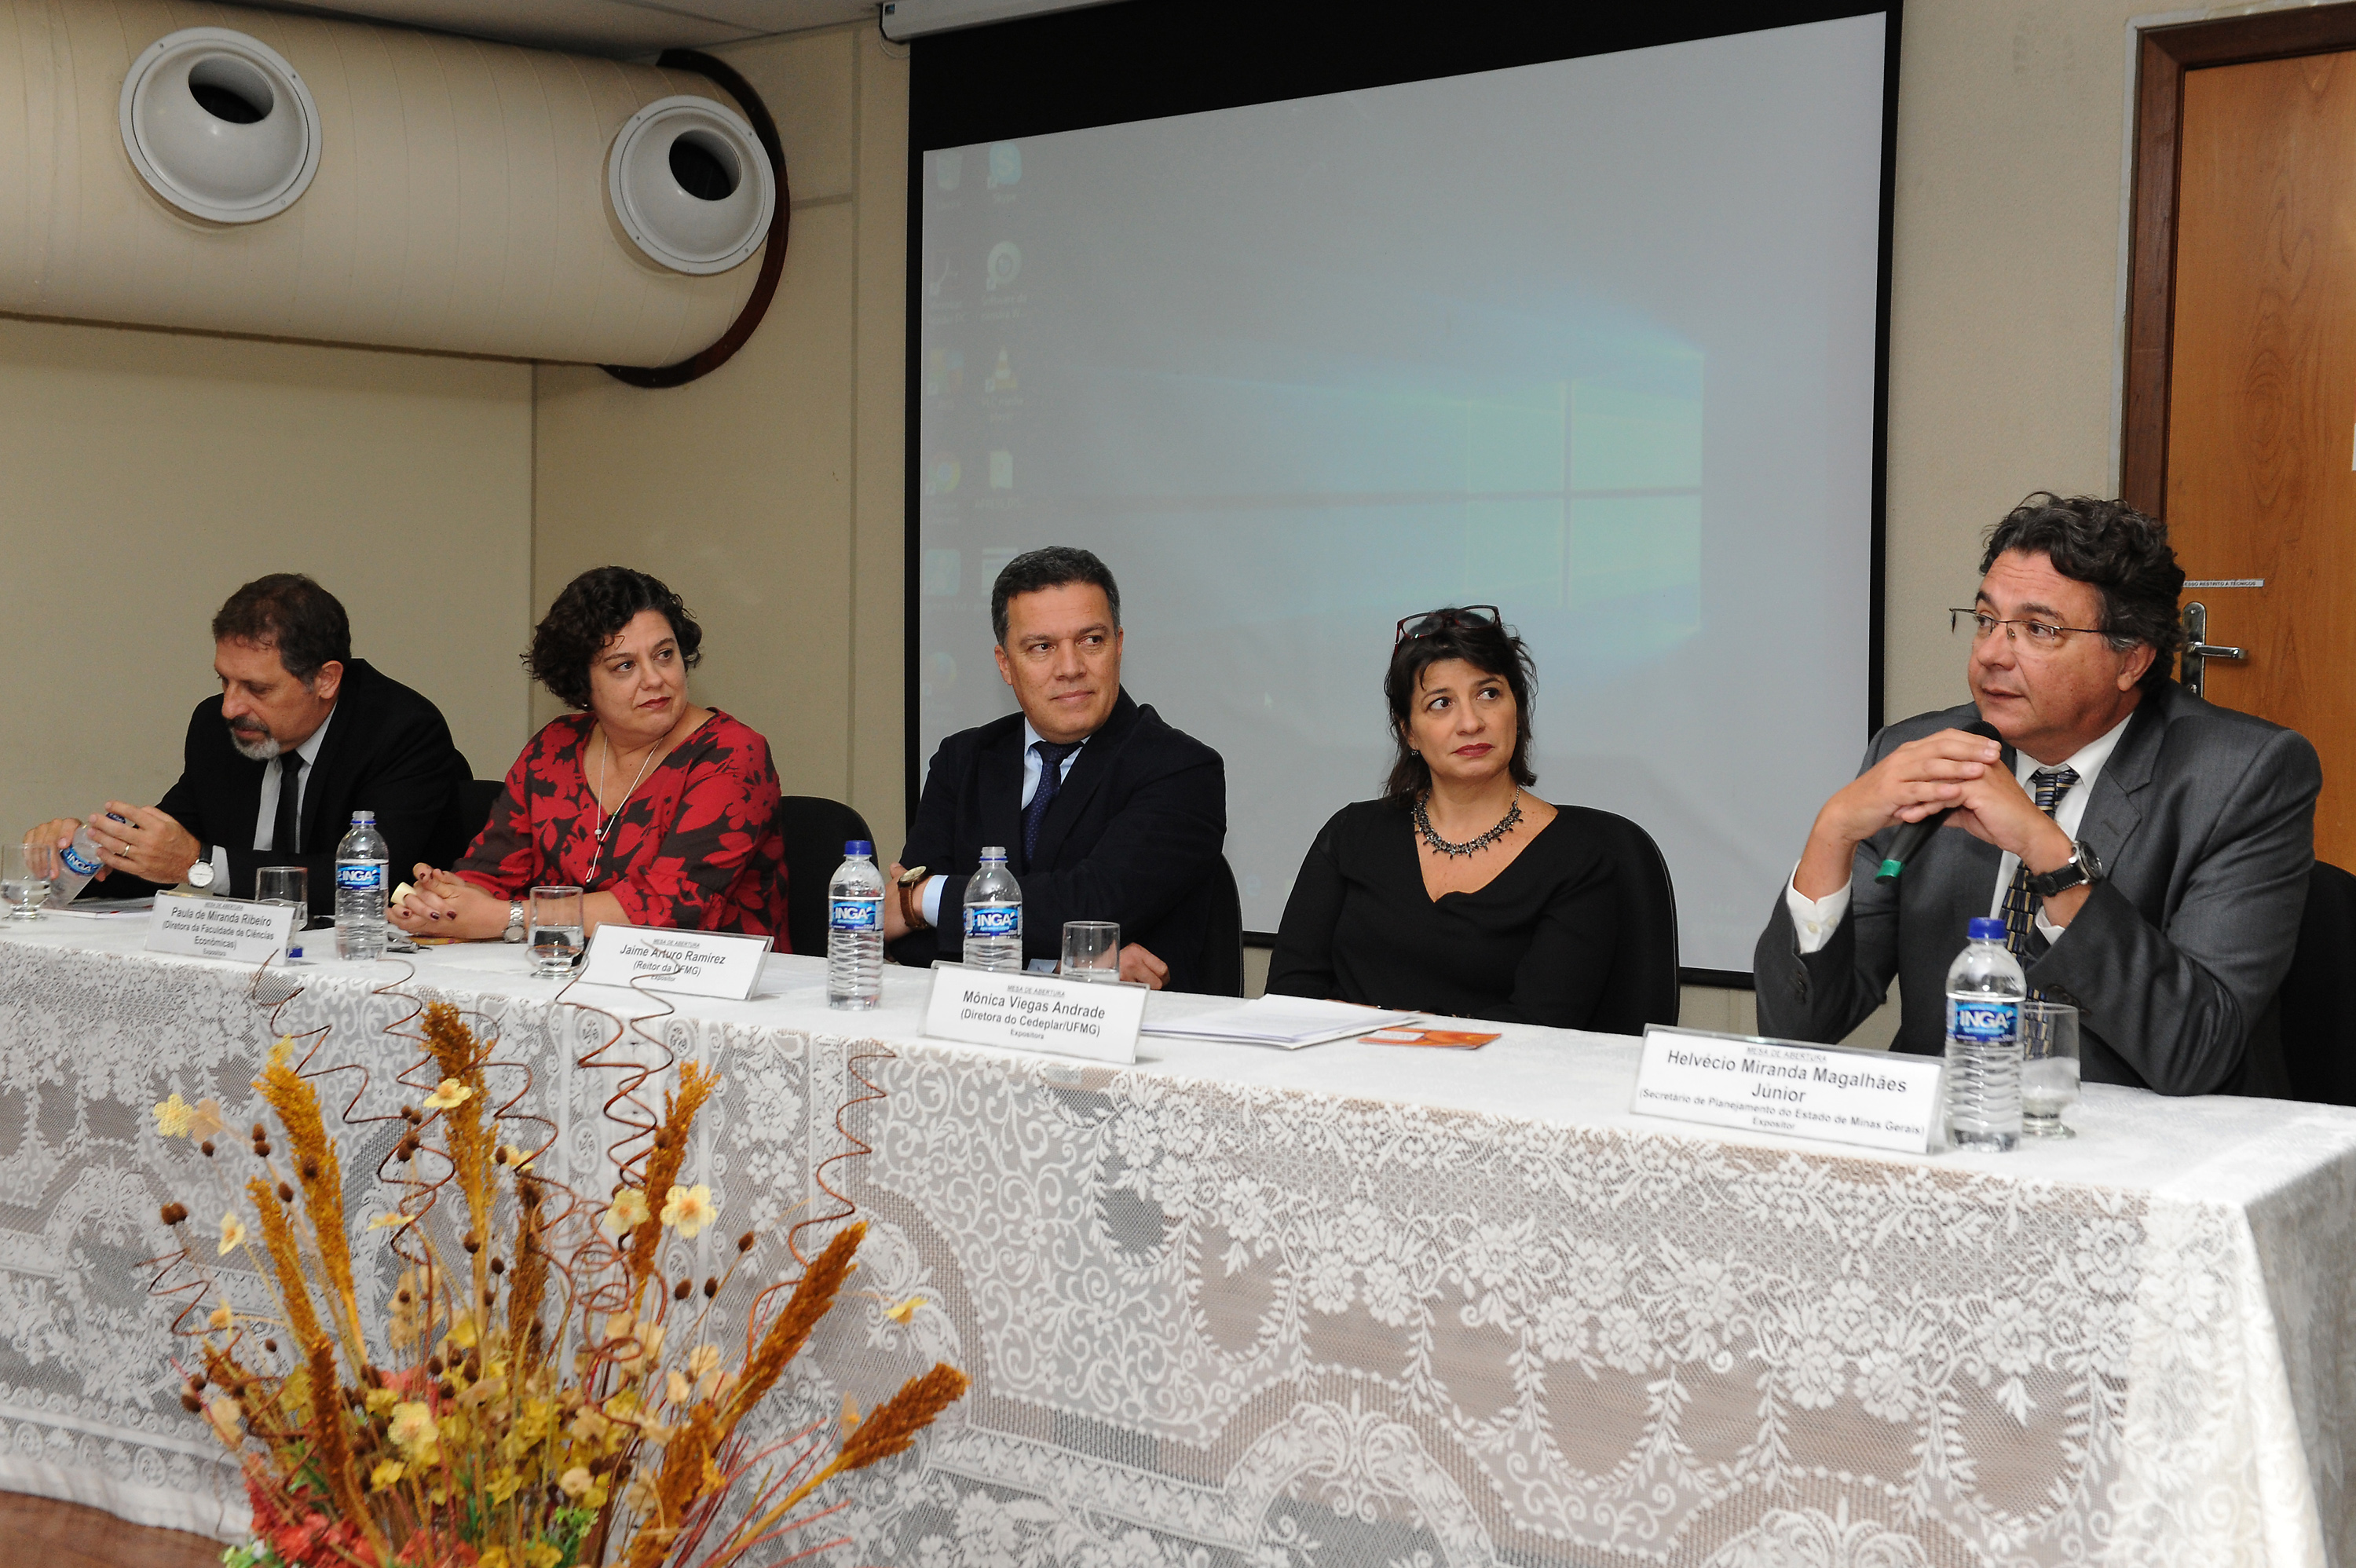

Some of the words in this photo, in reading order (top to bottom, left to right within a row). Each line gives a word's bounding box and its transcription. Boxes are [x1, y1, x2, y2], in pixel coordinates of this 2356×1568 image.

[171, 907, 193, 919] Paula
[196, 909, 205, 919] de
[207, 911, 239, 923] Miranda
[241, 914, 272, 927] Ribeiro
[162, 920, 190, 931] (Diretora
[201, 924, 234, 936] Faculdade
[246, 928, 273, 941] Ciências
[620, 944, 649, 956] Jaime
[650, 947, 682, 959] Arturo
[633, 960, 660, 970] (Reitor
[1033, 988, 1065, 997] ABERTURA
[963, 990, 1005, 1007] Mônica
[1010, 996, 1048, 1013] Viegas
[1052, 1001, 1106, 1019] Andrade
[960, 1008, 1002, 1022] (Diretora
[1004, 1014, 1017, 1025] do
[1019, 1015, 1101, 1037] Cedeplar/UFMG)
[1010, 1029, 1044, 1040] Expositora
[1667, 1050, 1736, 1071] Helvécio
[1741, 1058, 1806, 1080] Miranda
[1813, 1066, 1907, 1093] Magalhães
[1694, 1097, 1706, 1106] de
[1709, 1097, 1776, 1115] Planejamento
[1779, 1107, 1792, 1117] do
[1795, 1109, 1831, 1123] Estado
[1835, 1115, 1846, 1124] de
[1850, 1117, 1881, 1129] Minas
[1885, 1120, 1924, 1135] Gerais)
[1753, 1117, 1795, 1131] Expositor
